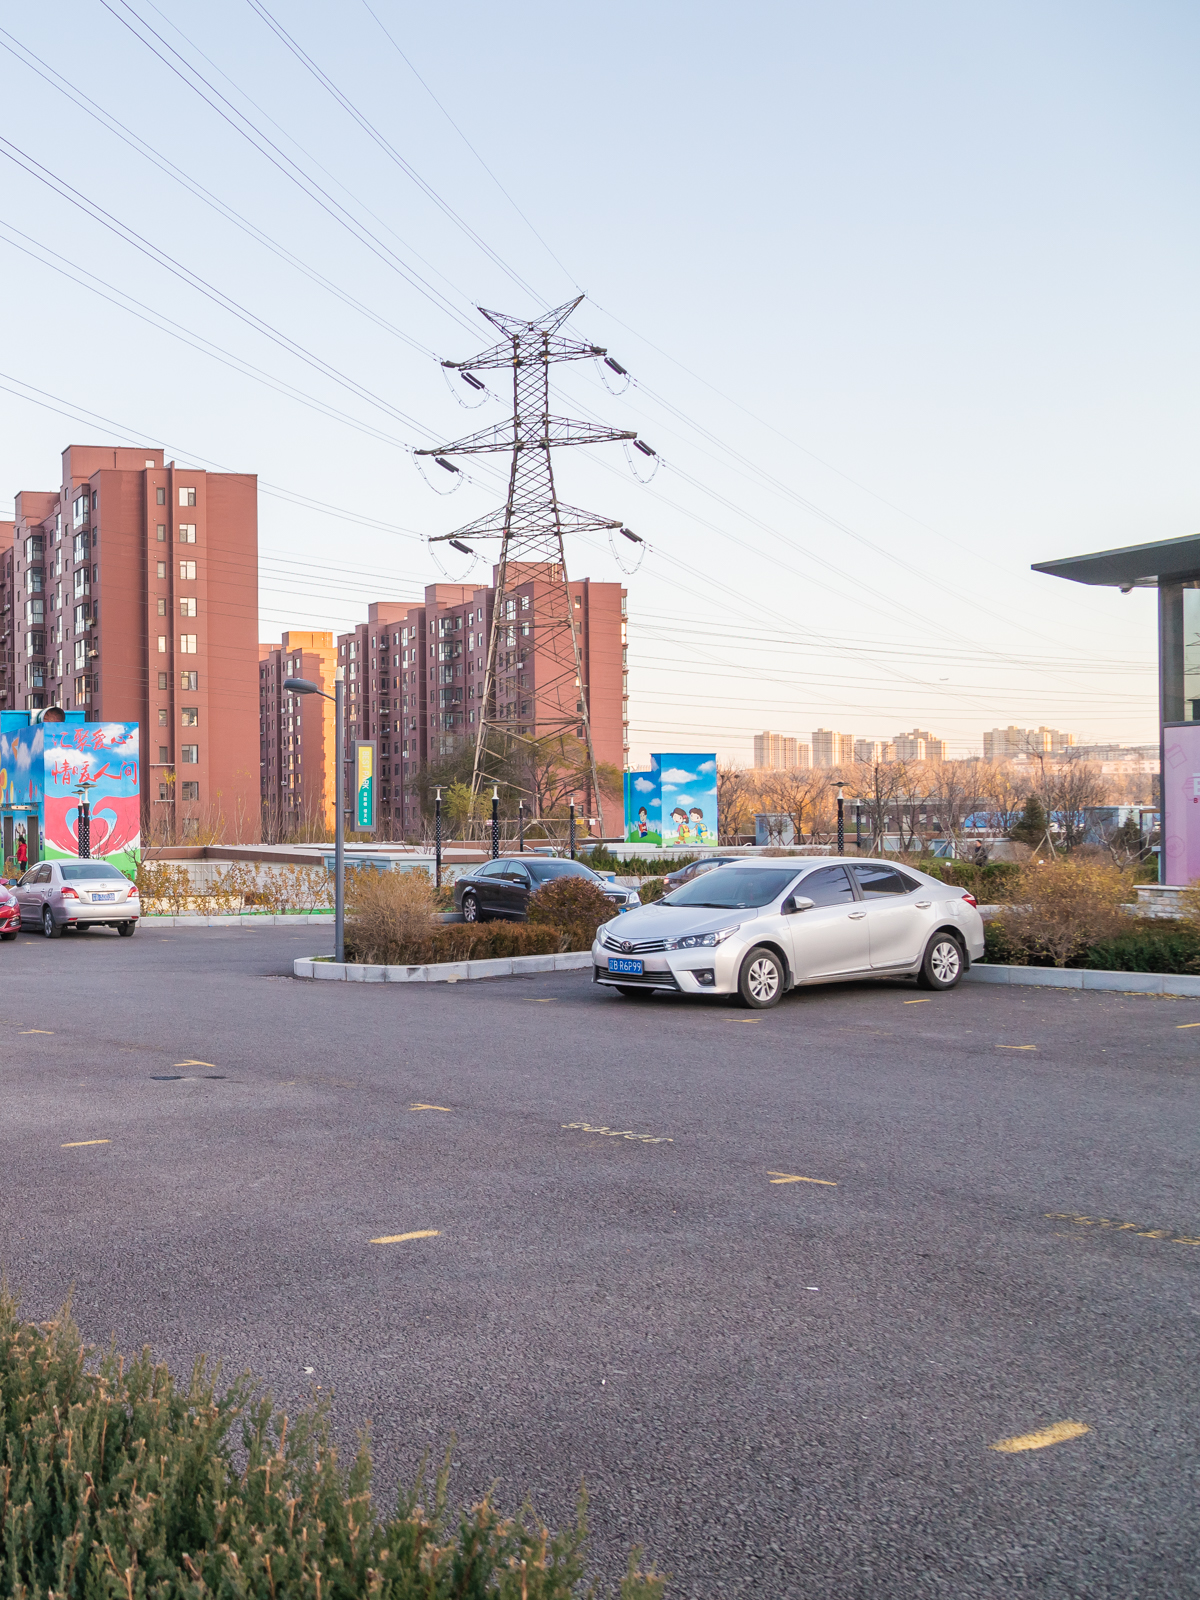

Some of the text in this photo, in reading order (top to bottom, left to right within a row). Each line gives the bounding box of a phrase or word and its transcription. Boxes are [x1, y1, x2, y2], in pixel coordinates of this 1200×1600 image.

[51, 728, 134, 752] 汇聚爱心
[362, 750, 370, 769] BEST
[51, 758, 137, 785] 情暖人间
[362, 770, 370, 790] PARK
